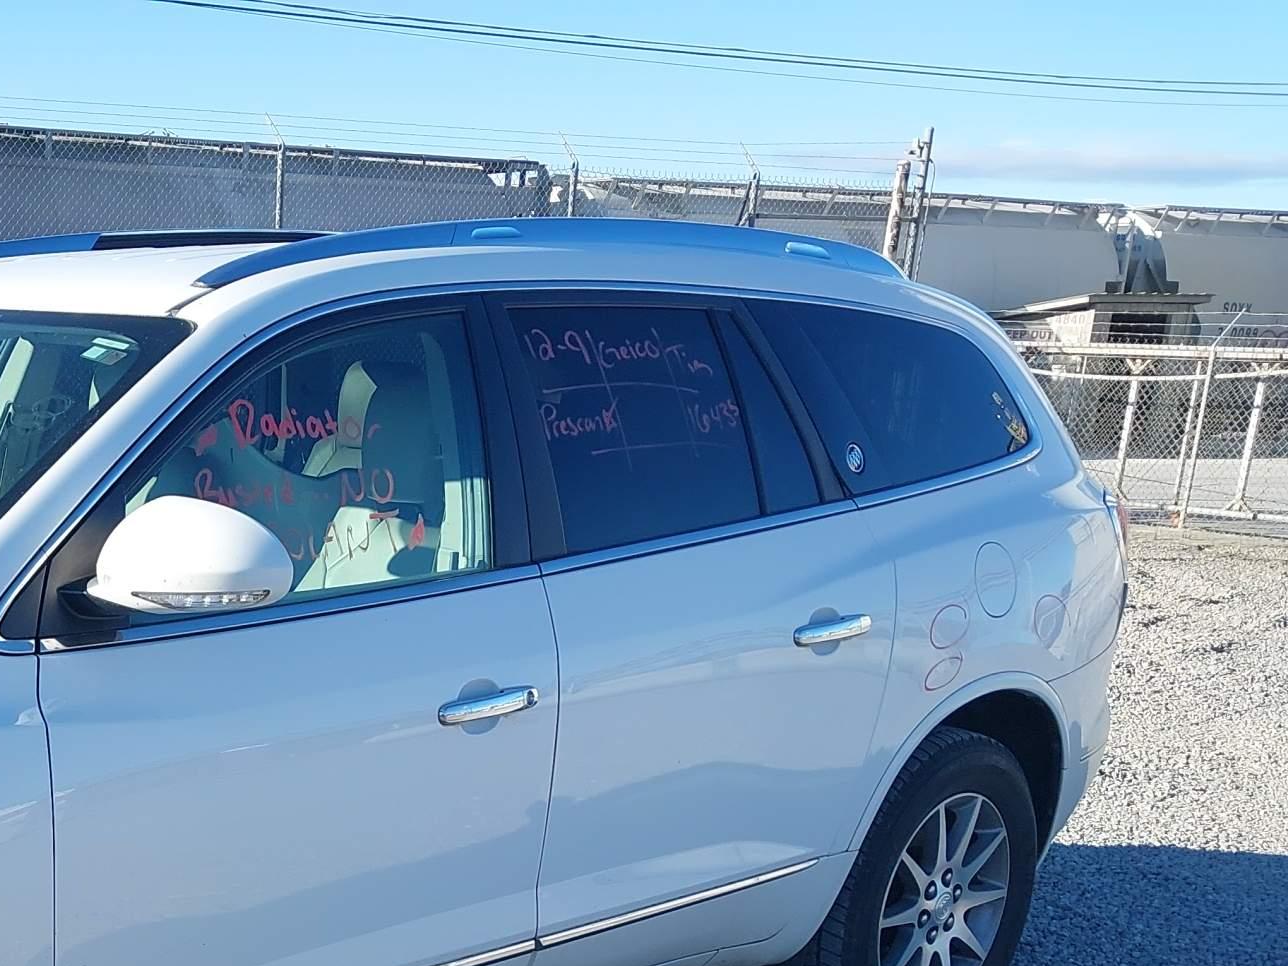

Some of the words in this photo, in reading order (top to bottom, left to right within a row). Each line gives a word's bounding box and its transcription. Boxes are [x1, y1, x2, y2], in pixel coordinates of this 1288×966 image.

[1006, 329, 1027, 340] EEP
[1031, 329, 1053, 340] OUT
[228, 399, 381, 449] Radiator
